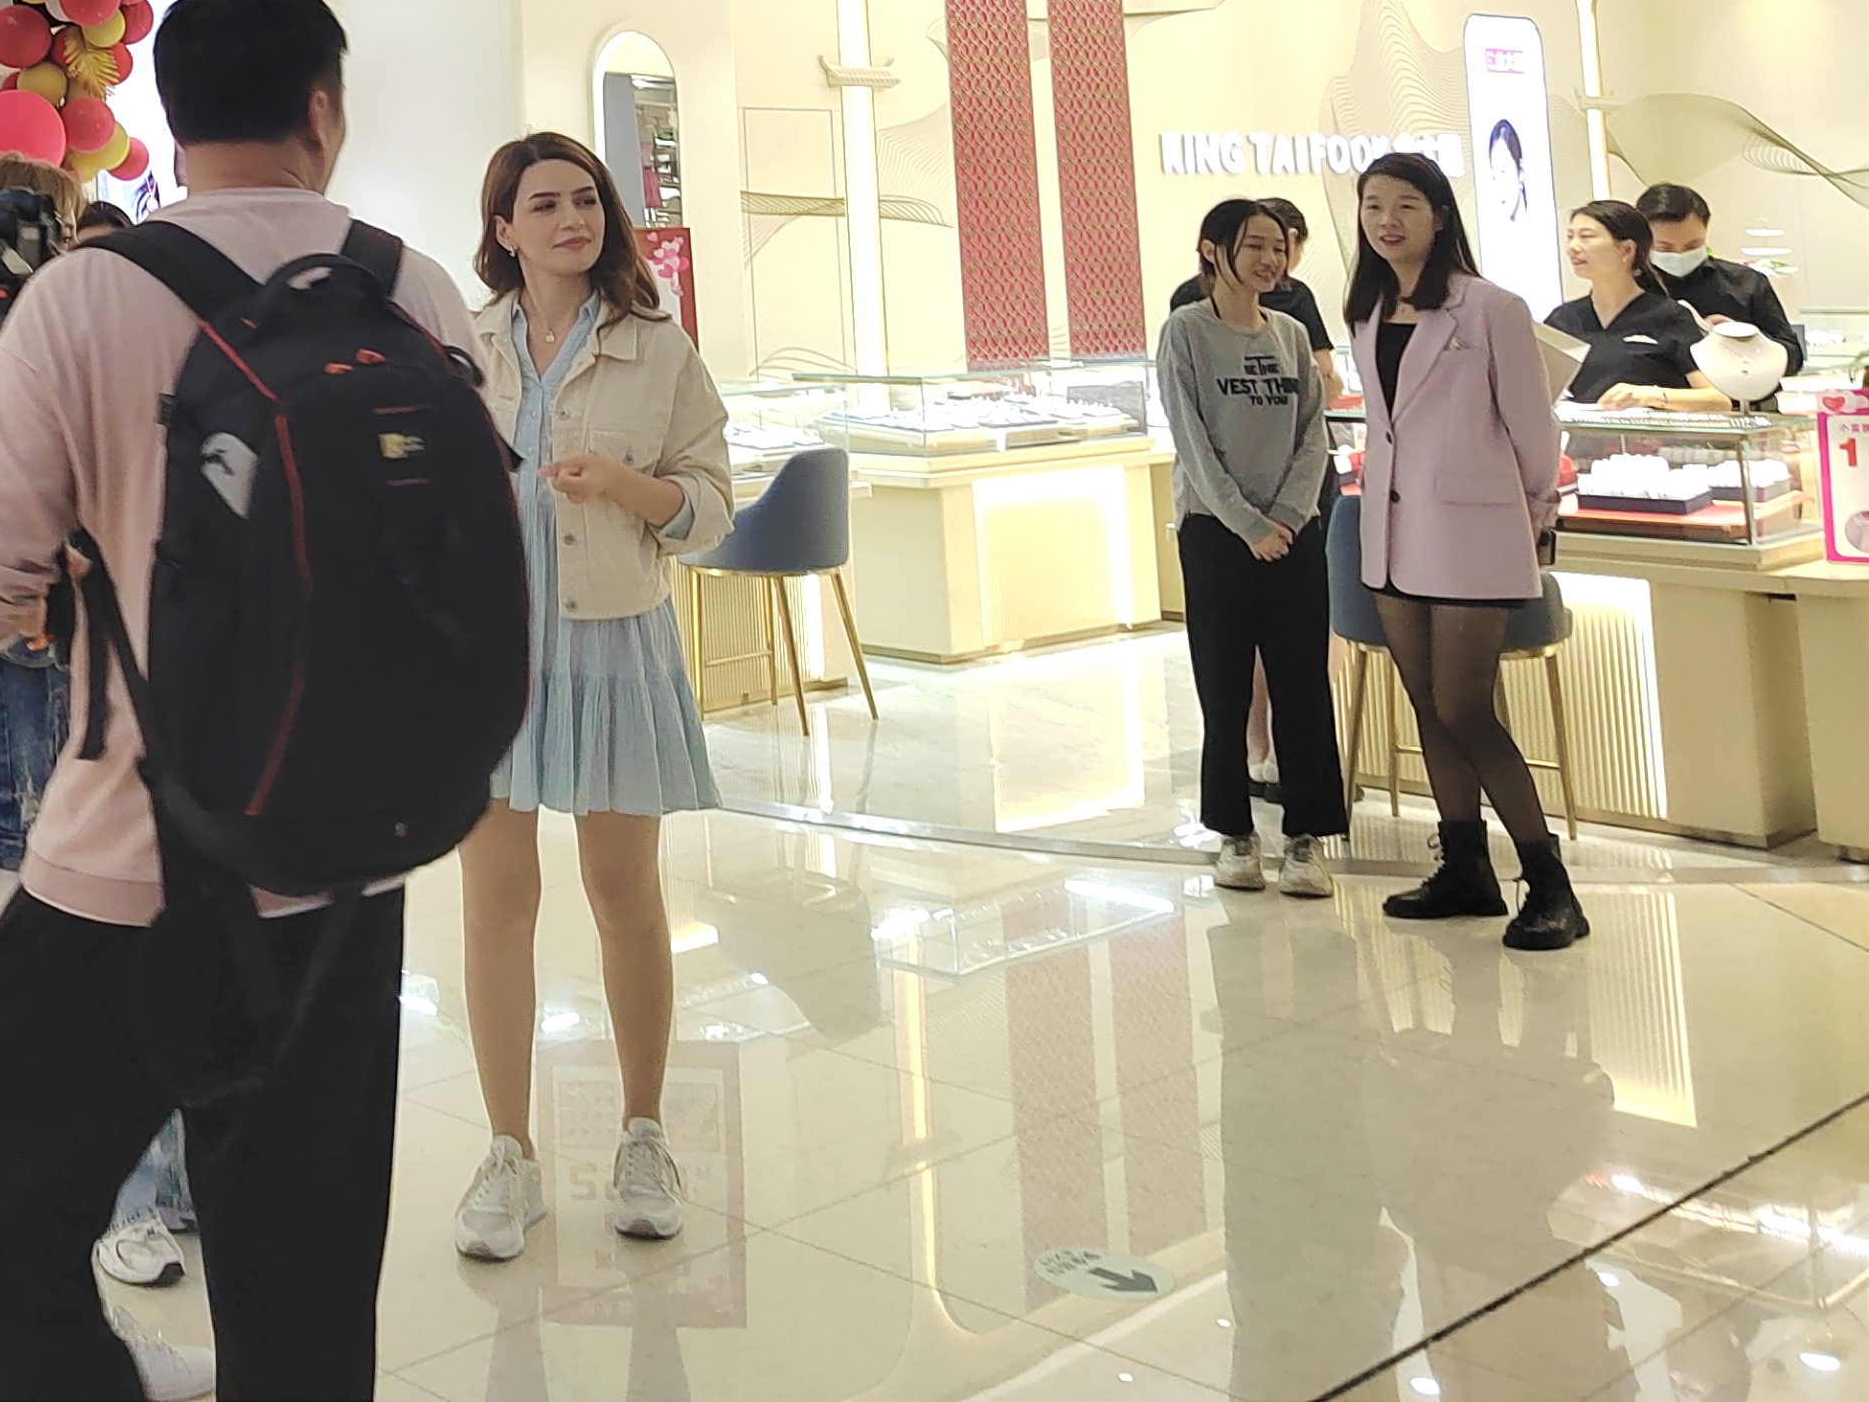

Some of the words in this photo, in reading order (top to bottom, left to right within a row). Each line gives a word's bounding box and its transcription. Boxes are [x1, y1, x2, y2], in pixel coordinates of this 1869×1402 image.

[1159, 131, 1247, 175] KING
[1248, 131, 1307, 175] TAI
[1216, 378, 1258, 396] VEST
[1250, 397, 1263, 406] TO
[1266, 396, 1288, 406] YOU
